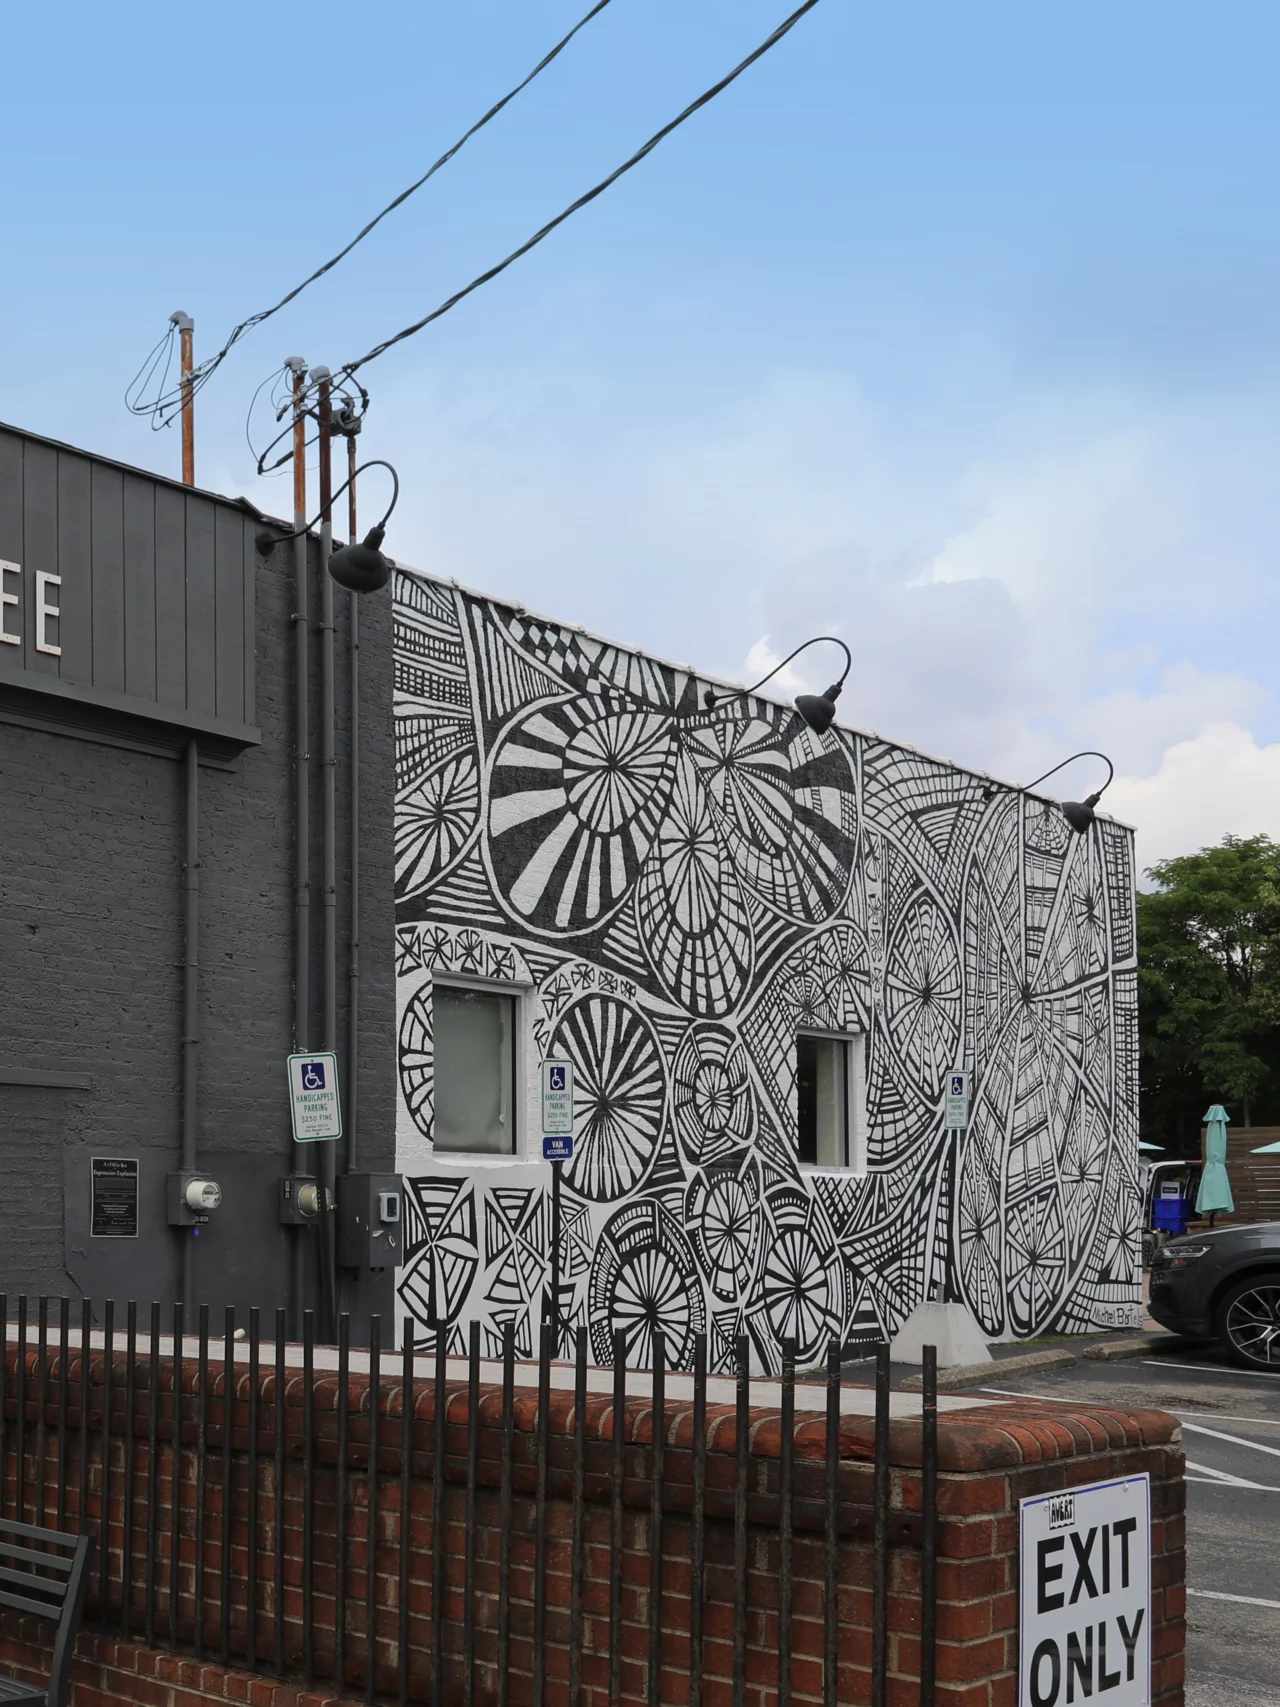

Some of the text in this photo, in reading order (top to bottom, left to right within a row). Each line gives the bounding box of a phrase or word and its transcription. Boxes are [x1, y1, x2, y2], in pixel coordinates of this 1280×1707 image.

[295, 1092, 335, 1103] HANDICAPPED
[545, 1093, 570, 1101] HANDICAPPED
[304, 1102, 328, 1112] PARKING
[549, 1102, 566, 1110] PARKING
[301, 1113, 333, 1123] $250 FINE
[551, 1140, 564, 1148] VAN
[1091, 1305, 1115, 1324] Michael
[1036, 1516, 1138, 1615] EXIT
[1029, 1607, 1146, 1707] ONLY
